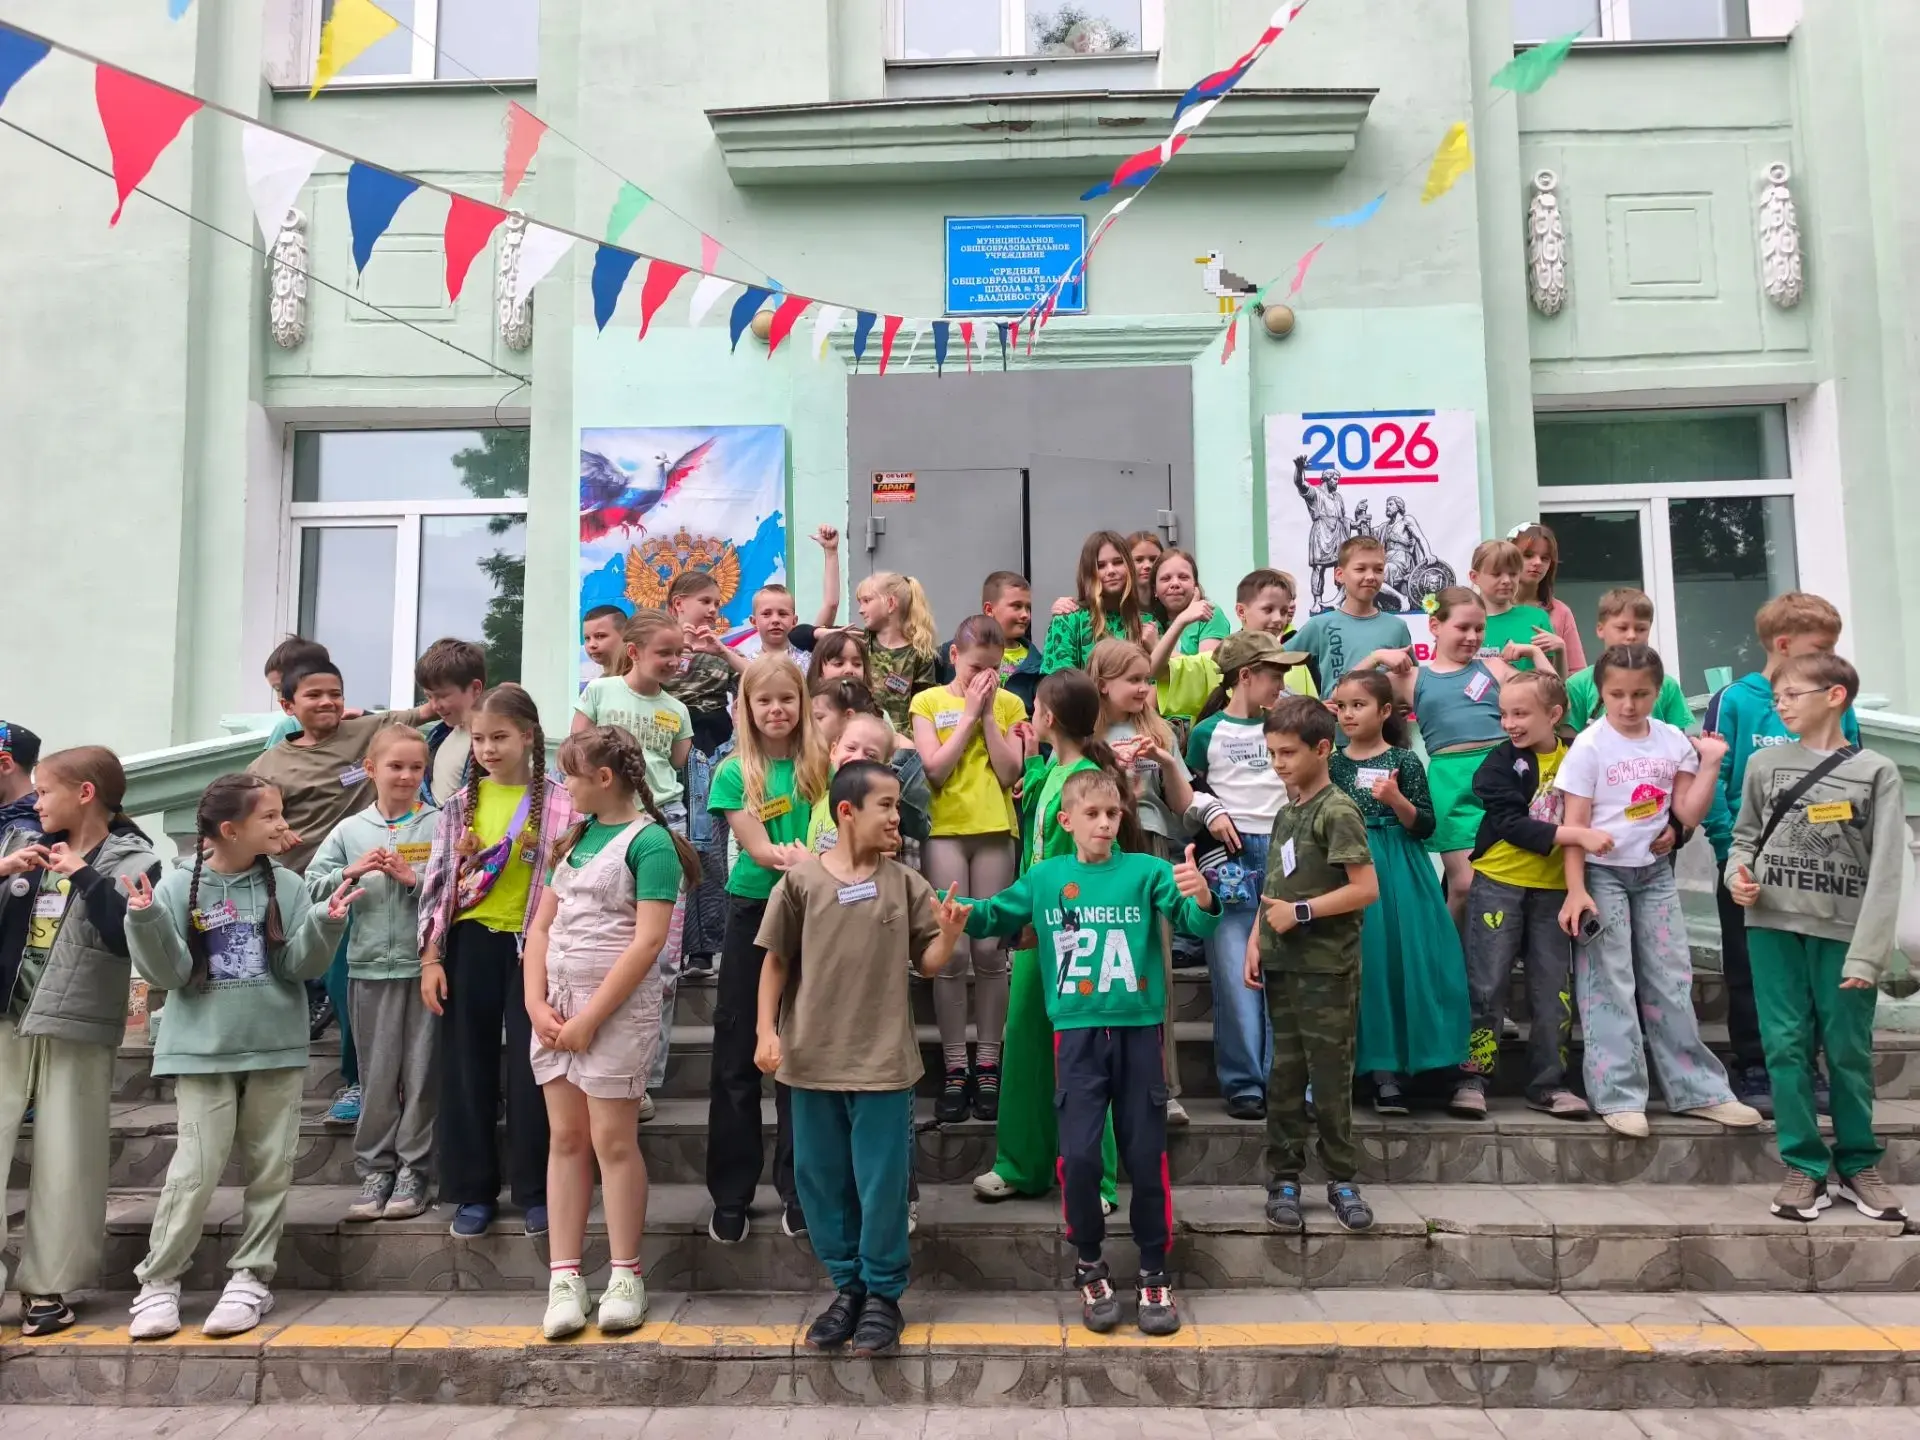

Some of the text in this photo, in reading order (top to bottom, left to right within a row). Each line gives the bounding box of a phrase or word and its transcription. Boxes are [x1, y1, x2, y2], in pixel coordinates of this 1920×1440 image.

[976, 236, 1054, 245] МУНИЦИПАЛЬНОЕ
[960, 243, 1070, 252] ОБЩЕОБРАЗОВАТЕЛЬНОЕ
[985, 251, 1045, 259] УЧРЕЖДЕНИЕ
[984, 284, 1022, 293] ШКОЛА
[1034, 284, 1045, 292] 32
[1302, 421, 1439, 472] 2026
[1823, 860, 1836, 873] IN
[1074, 905, 1142, 924] ANGELES
